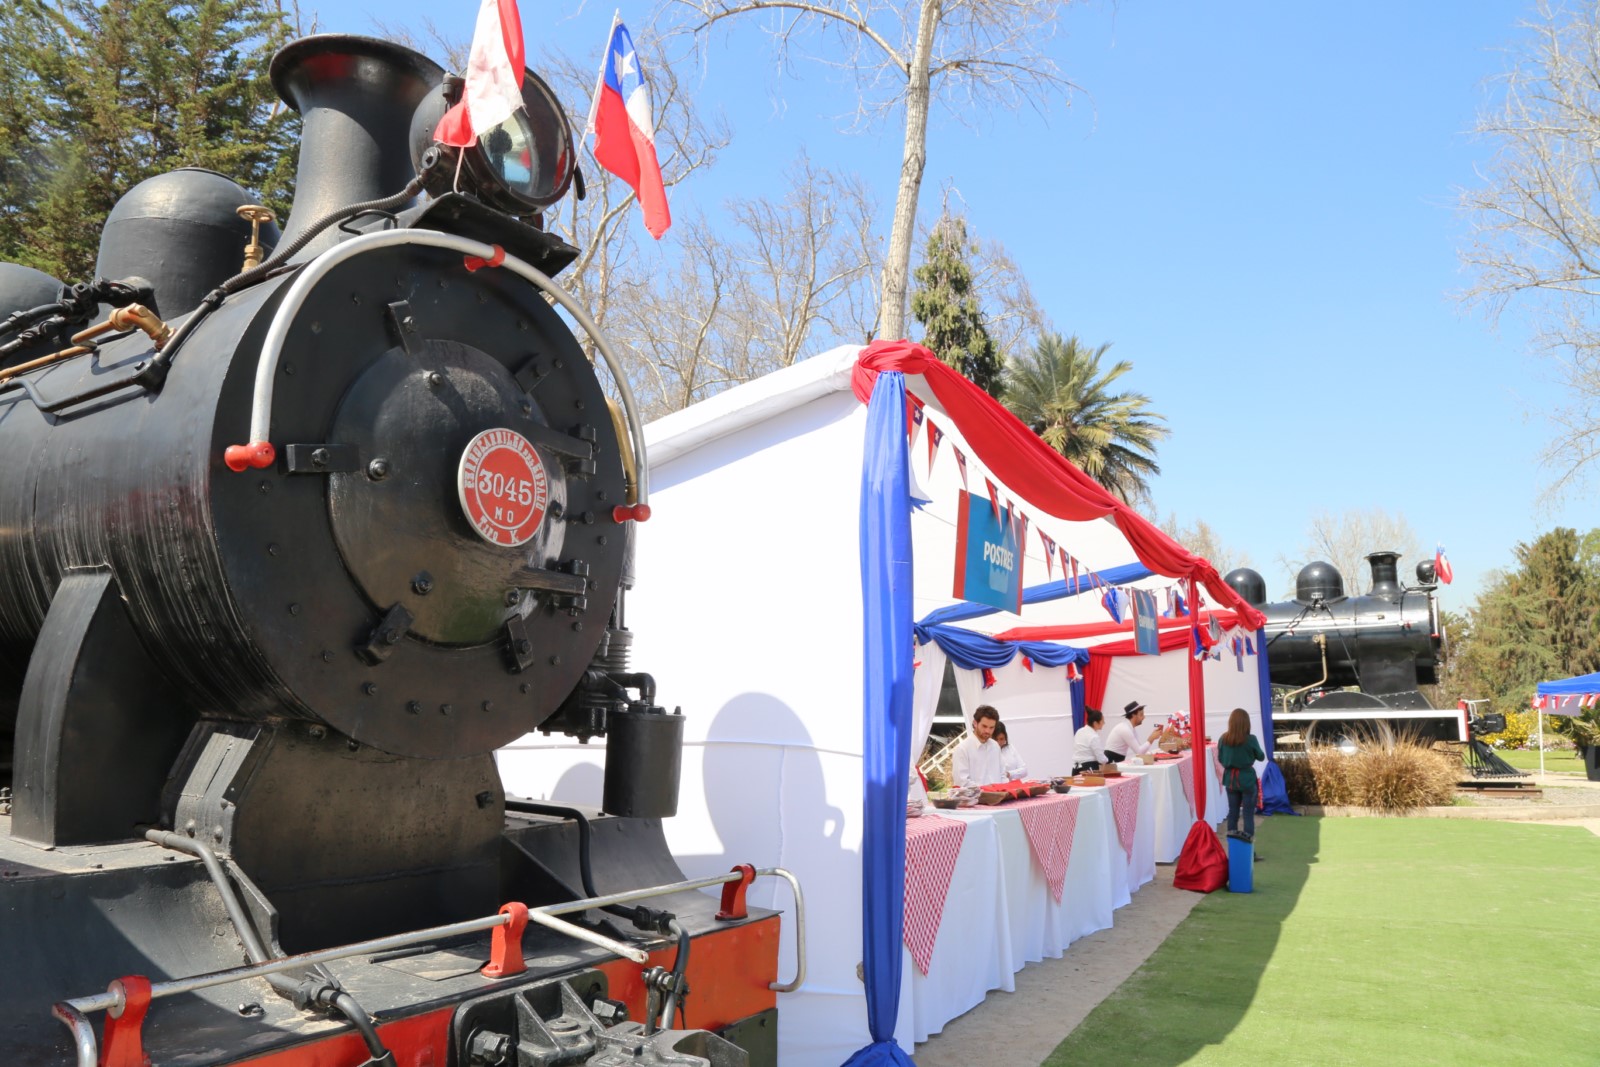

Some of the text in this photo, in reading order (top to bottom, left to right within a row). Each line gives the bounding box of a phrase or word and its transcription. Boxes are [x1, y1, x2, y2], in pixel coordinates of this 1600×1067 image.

[479, 468, 532, 506] 3045
[510, 529, 520, 544] K
[983, 541, 1014, 572] POSTRES
